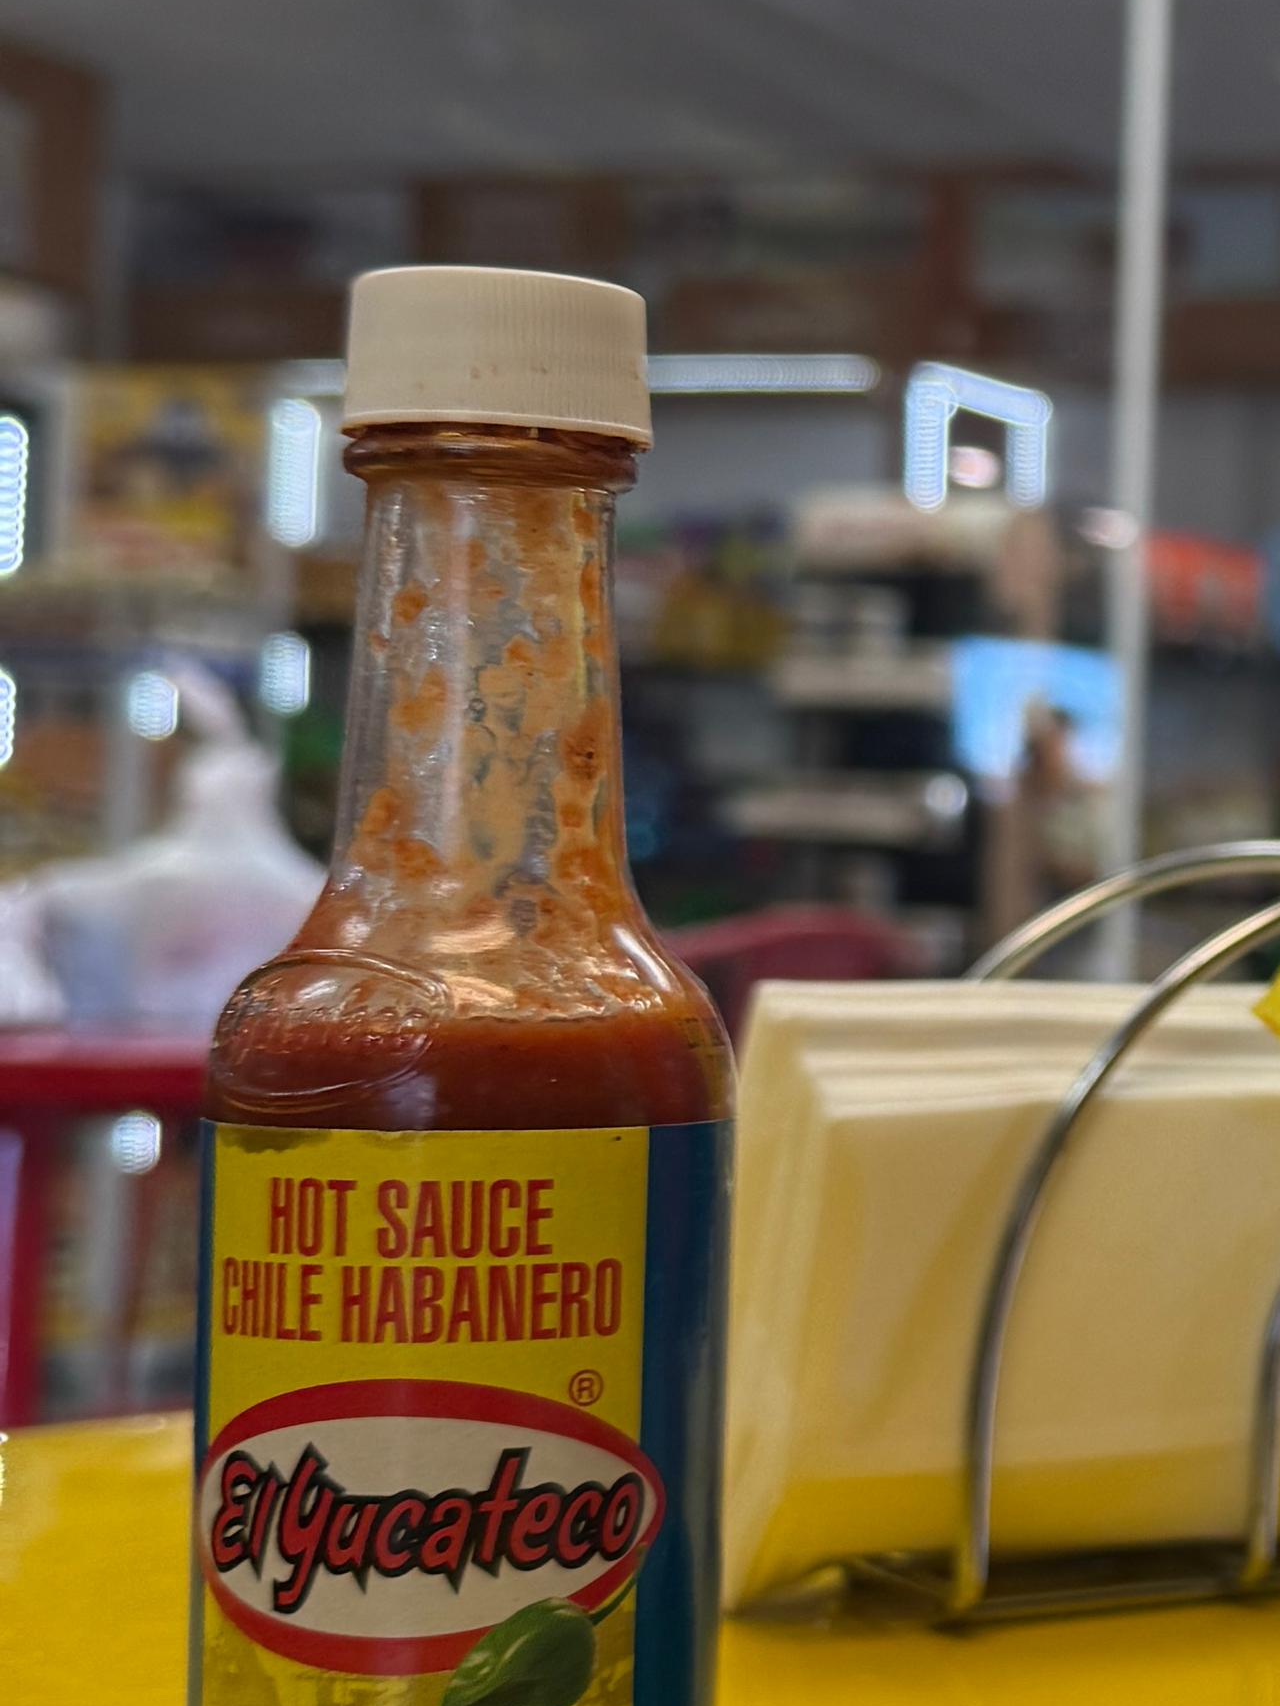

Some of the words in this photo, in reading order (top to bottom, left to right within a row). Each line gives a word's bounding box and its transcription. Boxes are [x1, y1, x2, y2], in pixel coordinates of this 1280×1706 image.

[268, 1176, 358, 1258] HOT
[375, 1177, 556, 1260] SAUCE
[221, 1256, 324, 1342] CHILE
[339, 1257, 624, 1345] HABANERO
[211, 1449, 288, 1582] El
[272, 1440, 645, 1615] Yucateco
